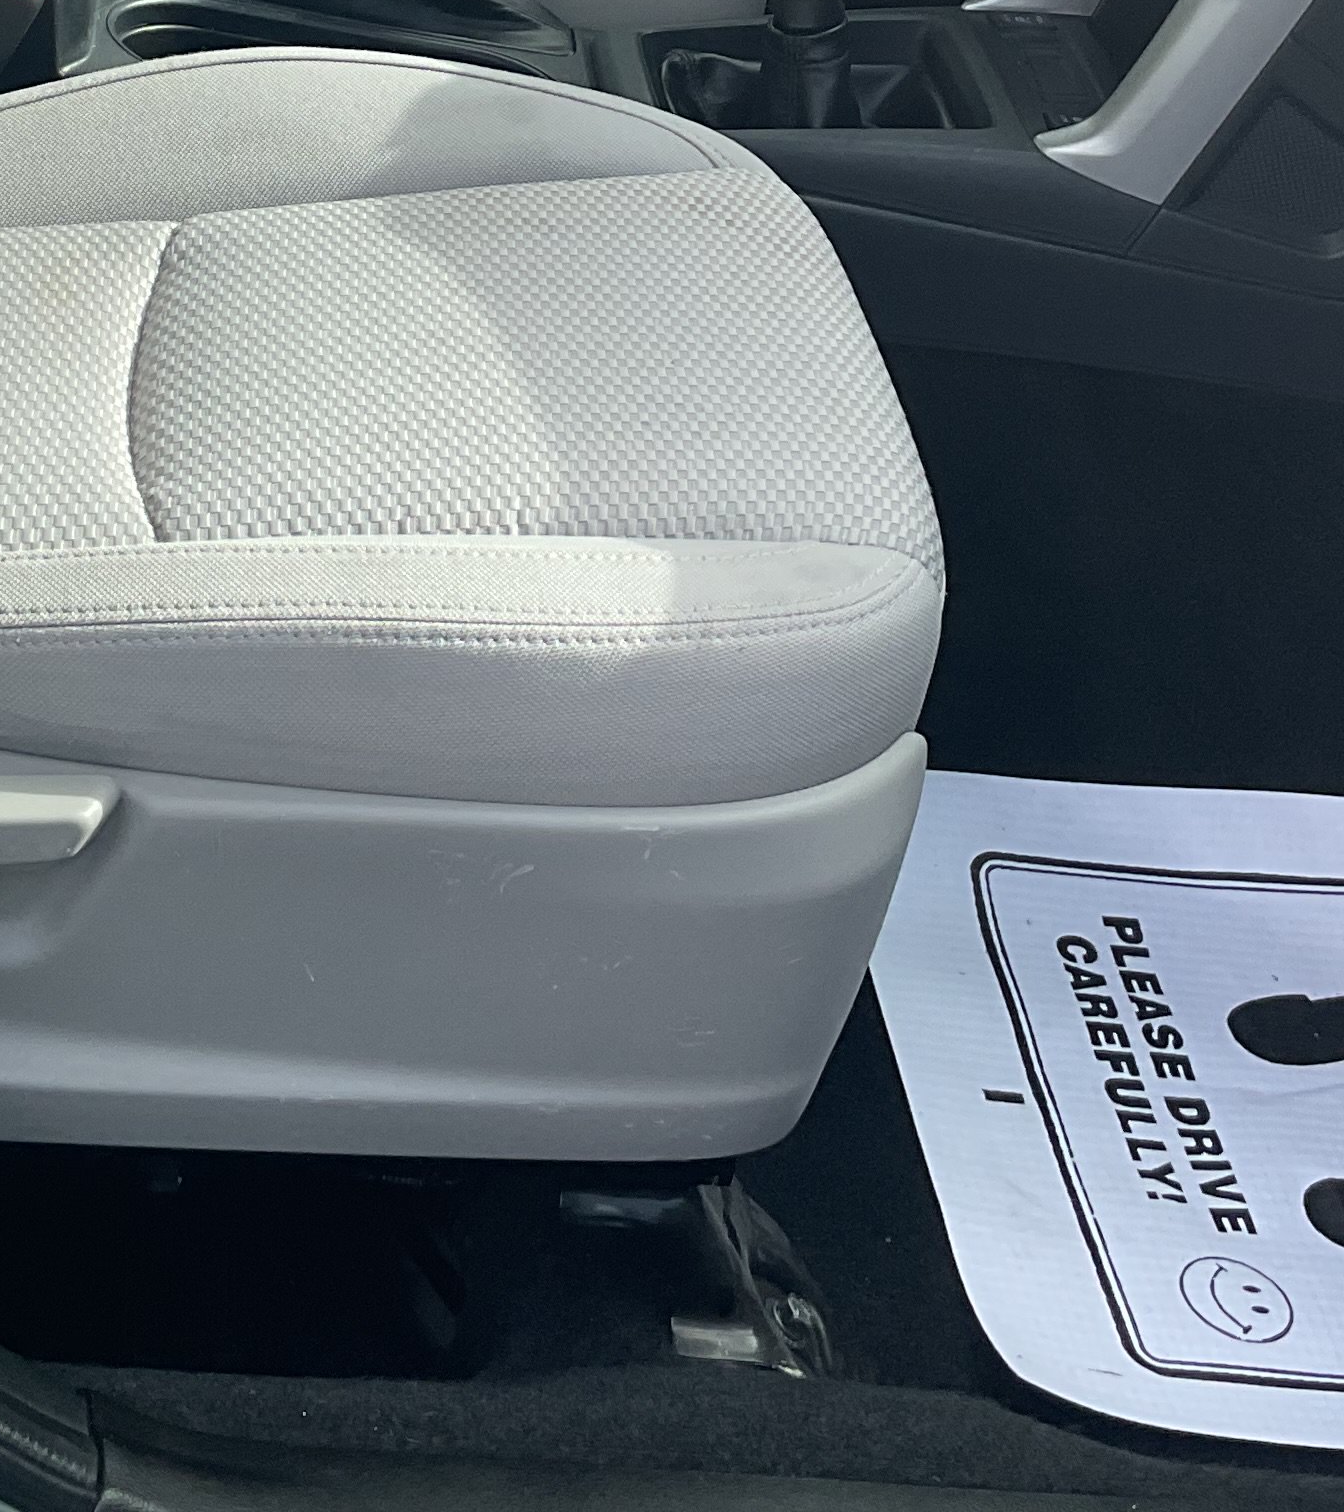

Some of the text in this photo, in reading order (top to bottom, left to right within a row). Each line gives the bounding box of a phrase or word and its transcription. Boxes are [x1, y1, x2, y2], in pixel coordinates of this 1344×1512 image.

[1056, 935, 1188, 1204] CAREFULLY!
[1102, 915, 1257, 1235] PLEASE DRIVE
